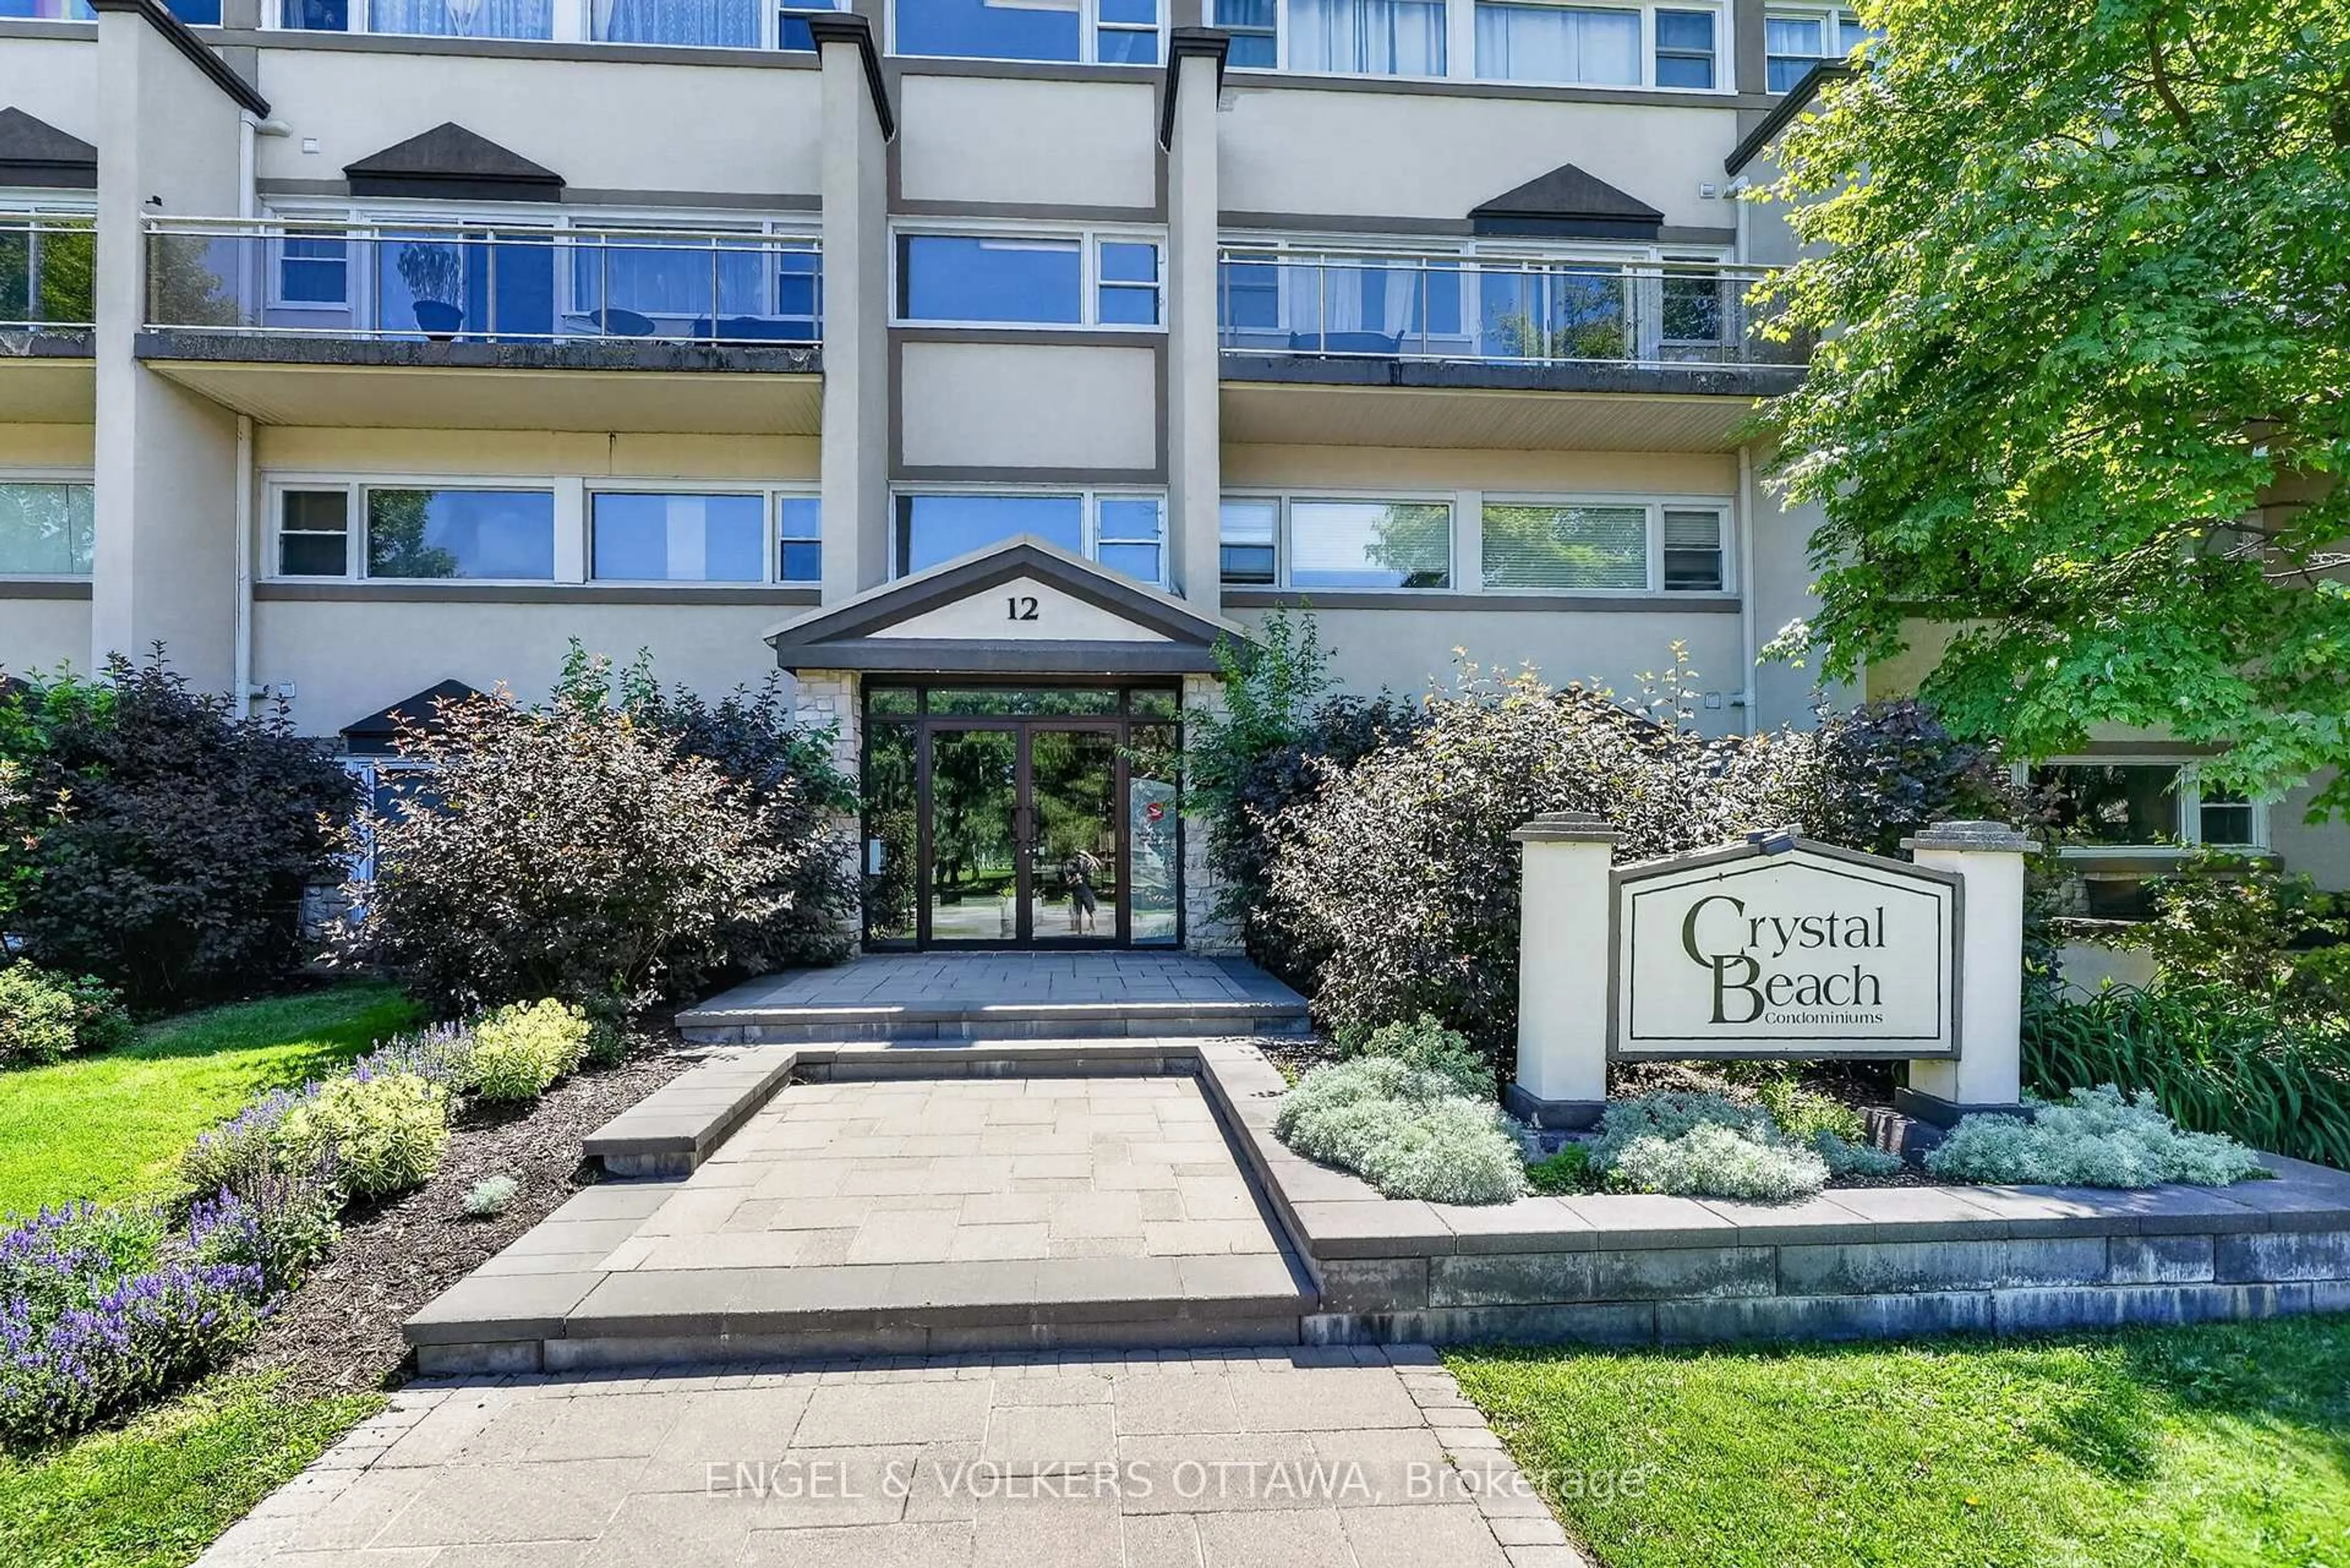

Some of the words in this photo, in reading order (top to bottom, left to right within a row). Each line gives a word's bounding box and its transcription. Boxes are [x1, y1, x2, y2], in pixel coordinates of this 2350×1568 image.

[1008, 597, 1039, 620] 12
[1682, 895, 1886, 969] Crystal
[1708, 954, 1882, 1024] Beach
[1765, 1011, 1883, 1025] Condominiums
